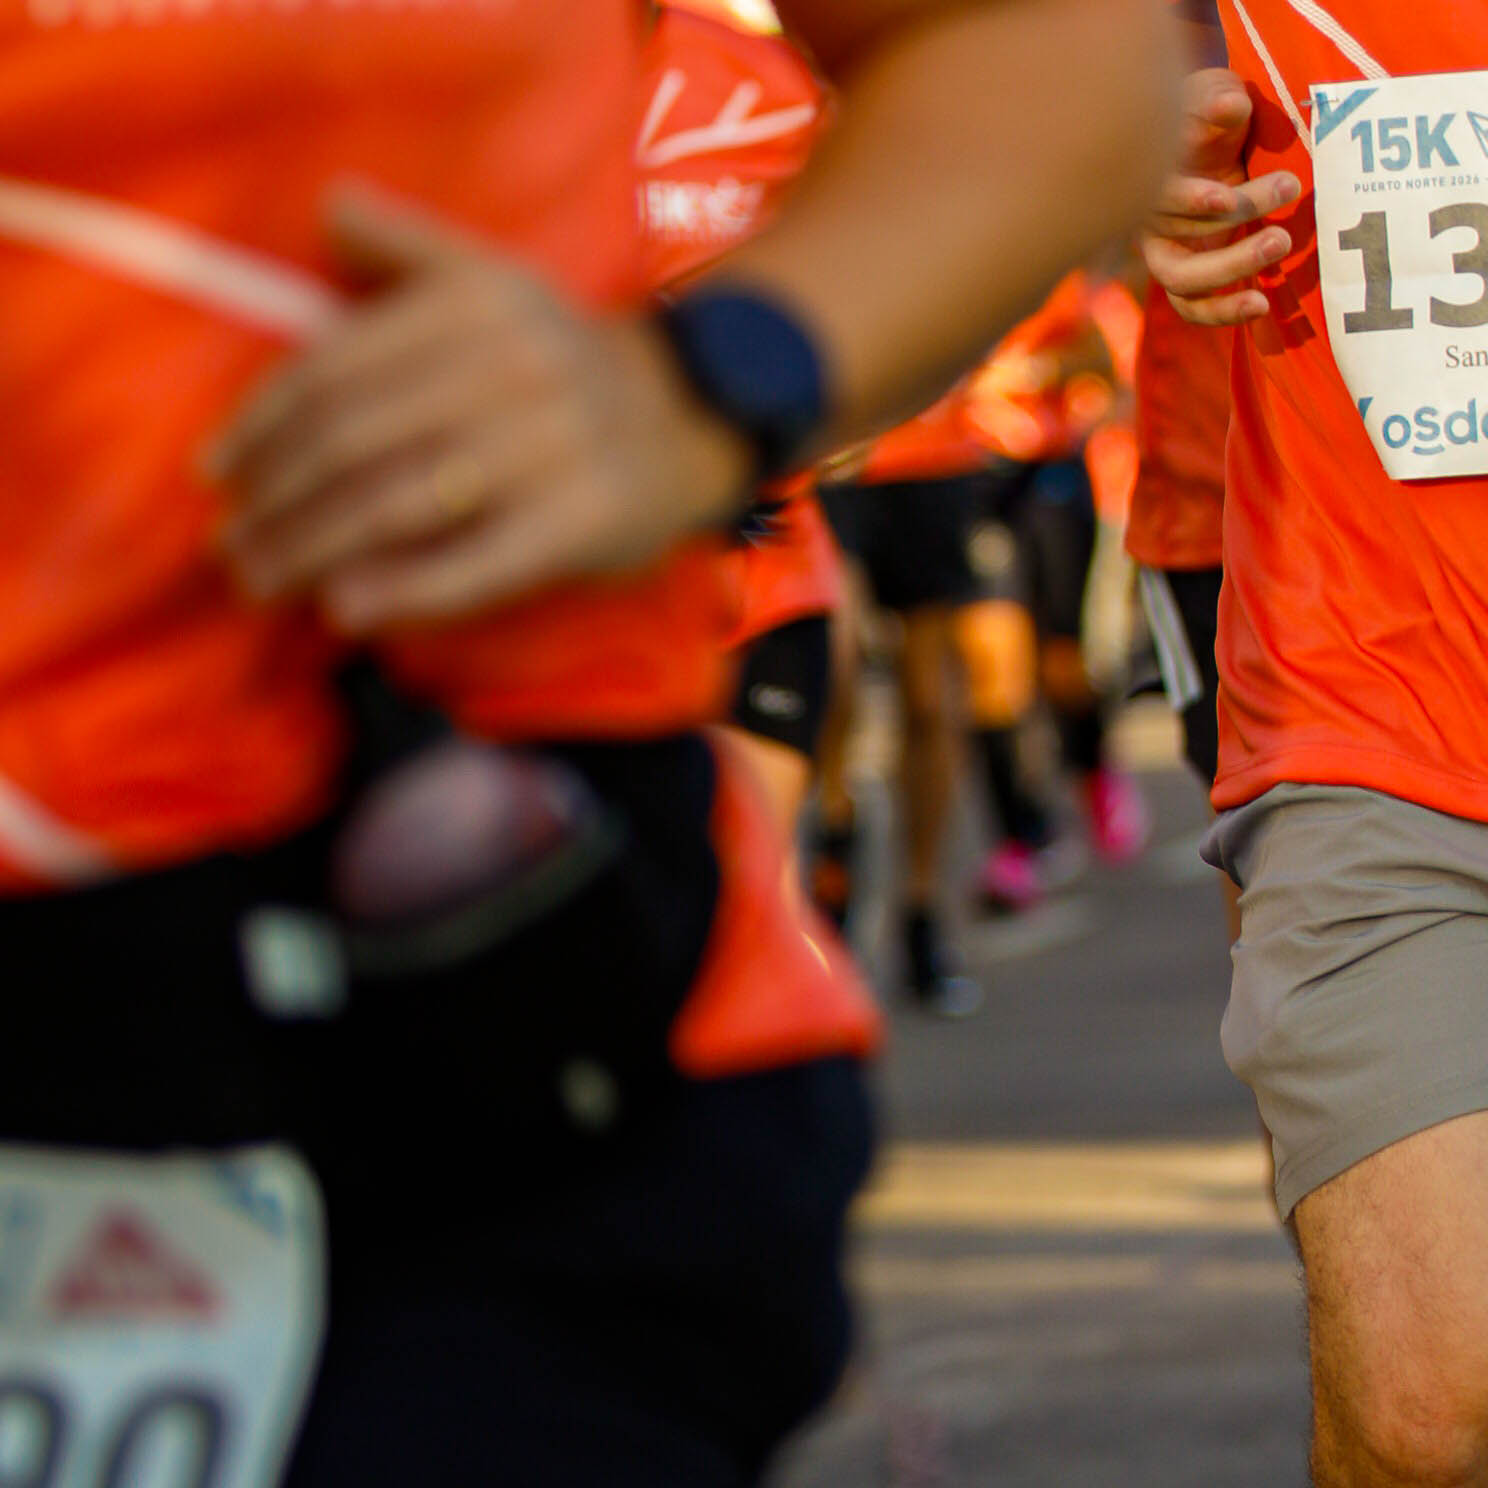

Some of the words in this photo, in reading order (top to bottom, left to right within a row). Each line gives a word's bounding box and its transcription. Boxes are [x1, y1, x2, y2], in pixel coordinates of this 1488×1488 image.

[1350, 112, 1460, 173] 15K
[1354, 180, 1401, 193] PUERTO
[1406, 178, 1447, 190] NORTE
[1450, 174, 1480, 186] 2026
